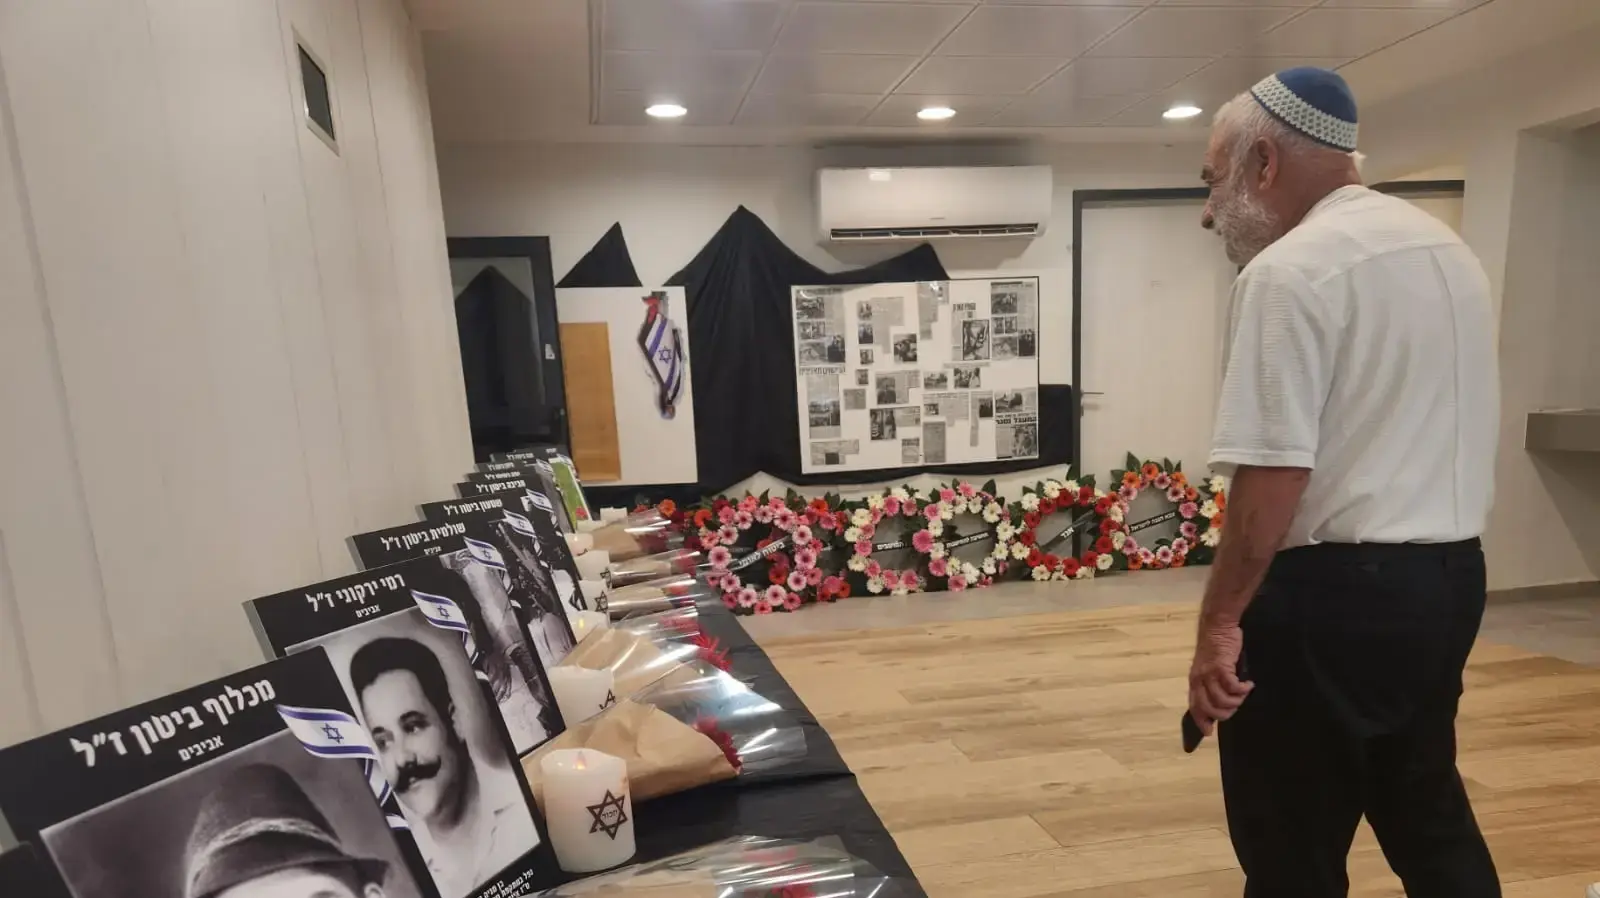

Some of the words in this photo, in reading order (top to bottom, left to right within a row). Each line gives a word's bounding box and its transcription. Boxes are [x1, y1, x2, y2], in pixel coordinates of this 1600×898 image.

[443, 504, 459, 516] ז"ל
[459, 502, 480, 514] ביטון
[479, 498, 503, 513] שמעון
[402, 530, 430, 550] ביטון
[429, 521, 466, 540] שולמית
[379, 536, 401, 551] ז"ל
[761, 541, 785, 557] ביטוח
[382, 573, 406, 592] רמי
[304, 590, 335, 612] ז"ל
[336, 580, 379, 605] ירקוני
[355, 604, 381, 619] אביבים
[202, 678, 276, 726] מכלוף
[129, 705, 204, 756] ביטון
[68, 731, 128, 768] ז"ל
[177, 734, 225, 762] אביבים
[522, 868, 534, 880] נפל
